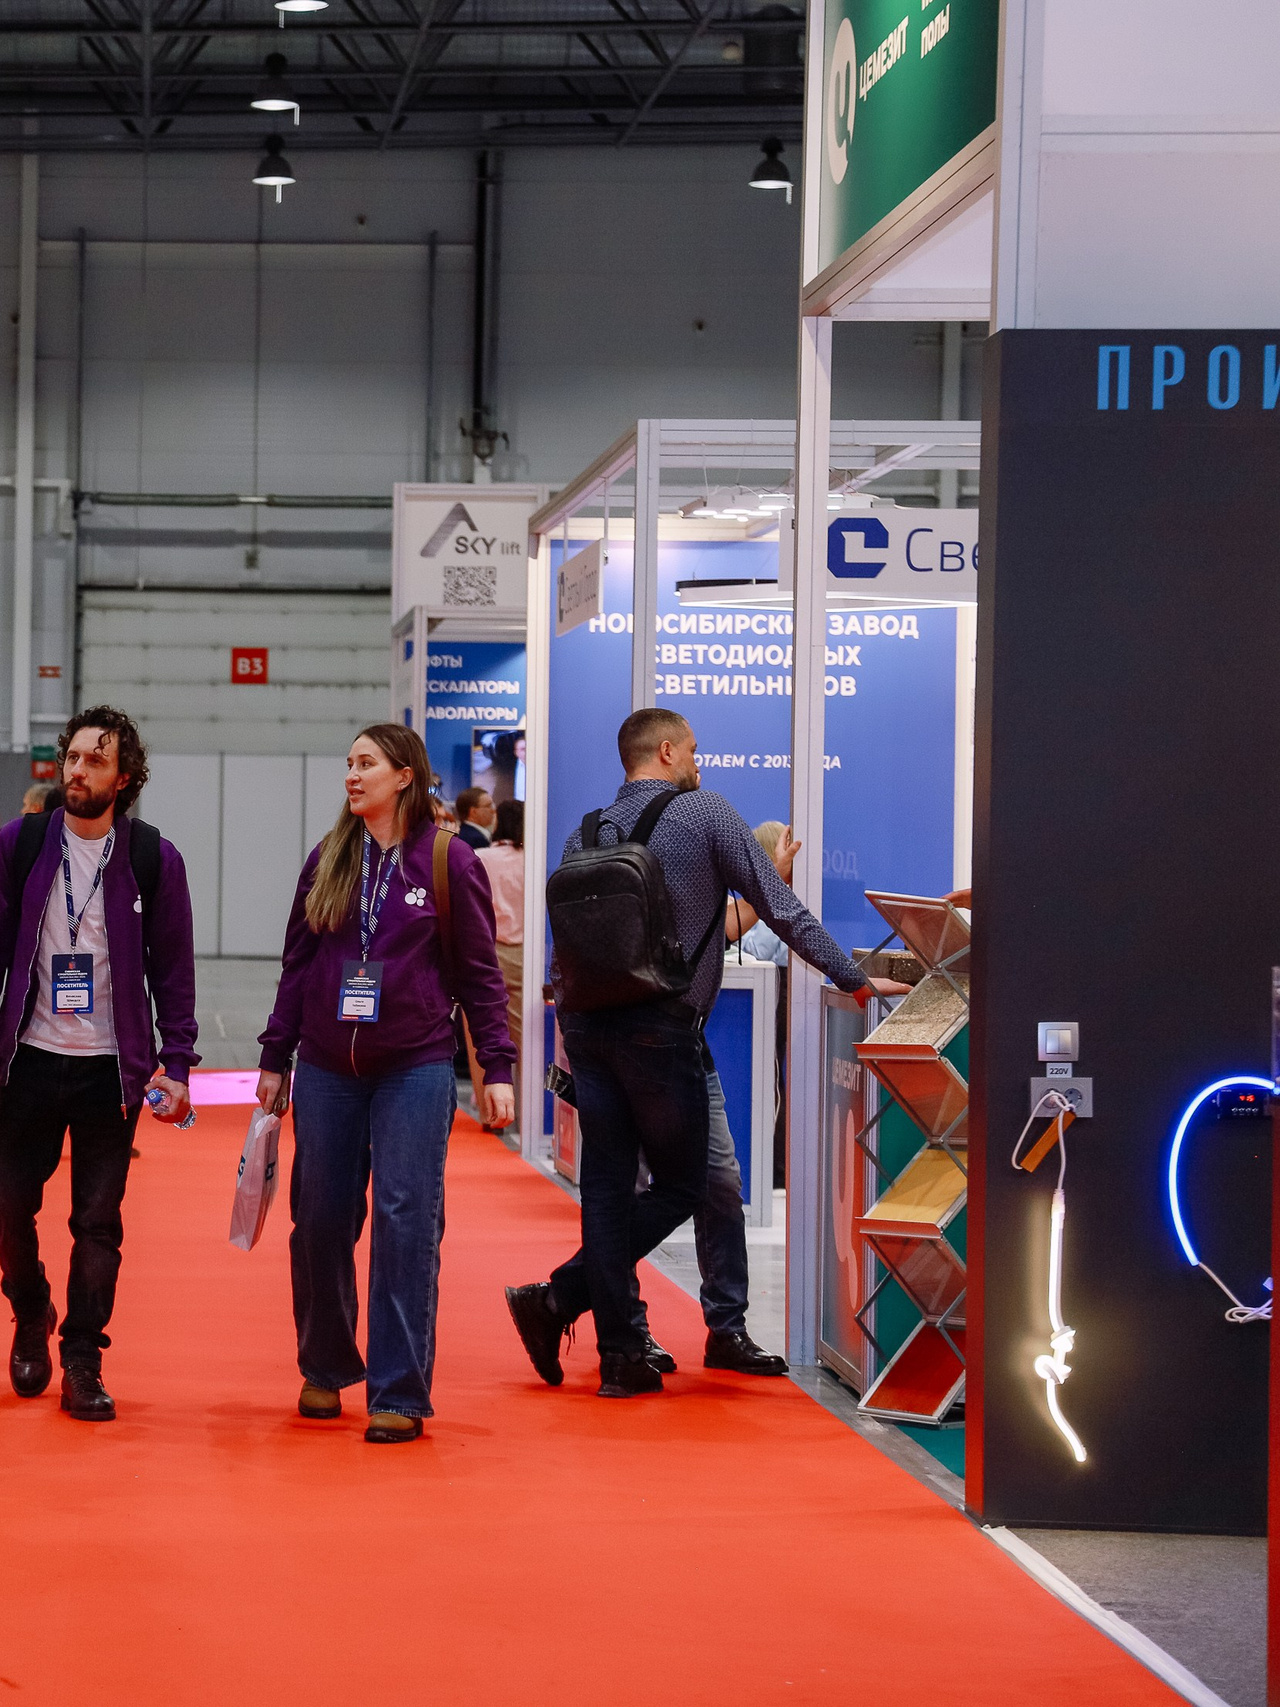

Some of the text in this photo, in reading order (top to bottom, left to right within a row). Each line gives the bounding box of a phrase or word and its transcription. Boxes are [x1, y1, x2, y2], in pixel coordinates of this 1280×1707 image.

[859, 15, 909, 102] ЦЕМЕЗИТ
[455, 536, 521, 555] SKY lift
[828, 614, 919, 639] ЗАВОД
[426, 655, 463, 669] ФТЫ
[426, 680, 520, 695] СКАЛАТОРЫ
[426, 706, 518, 721] АВОЛАТОРЫ
[1049, 1067, 1069, 1075] 220V
